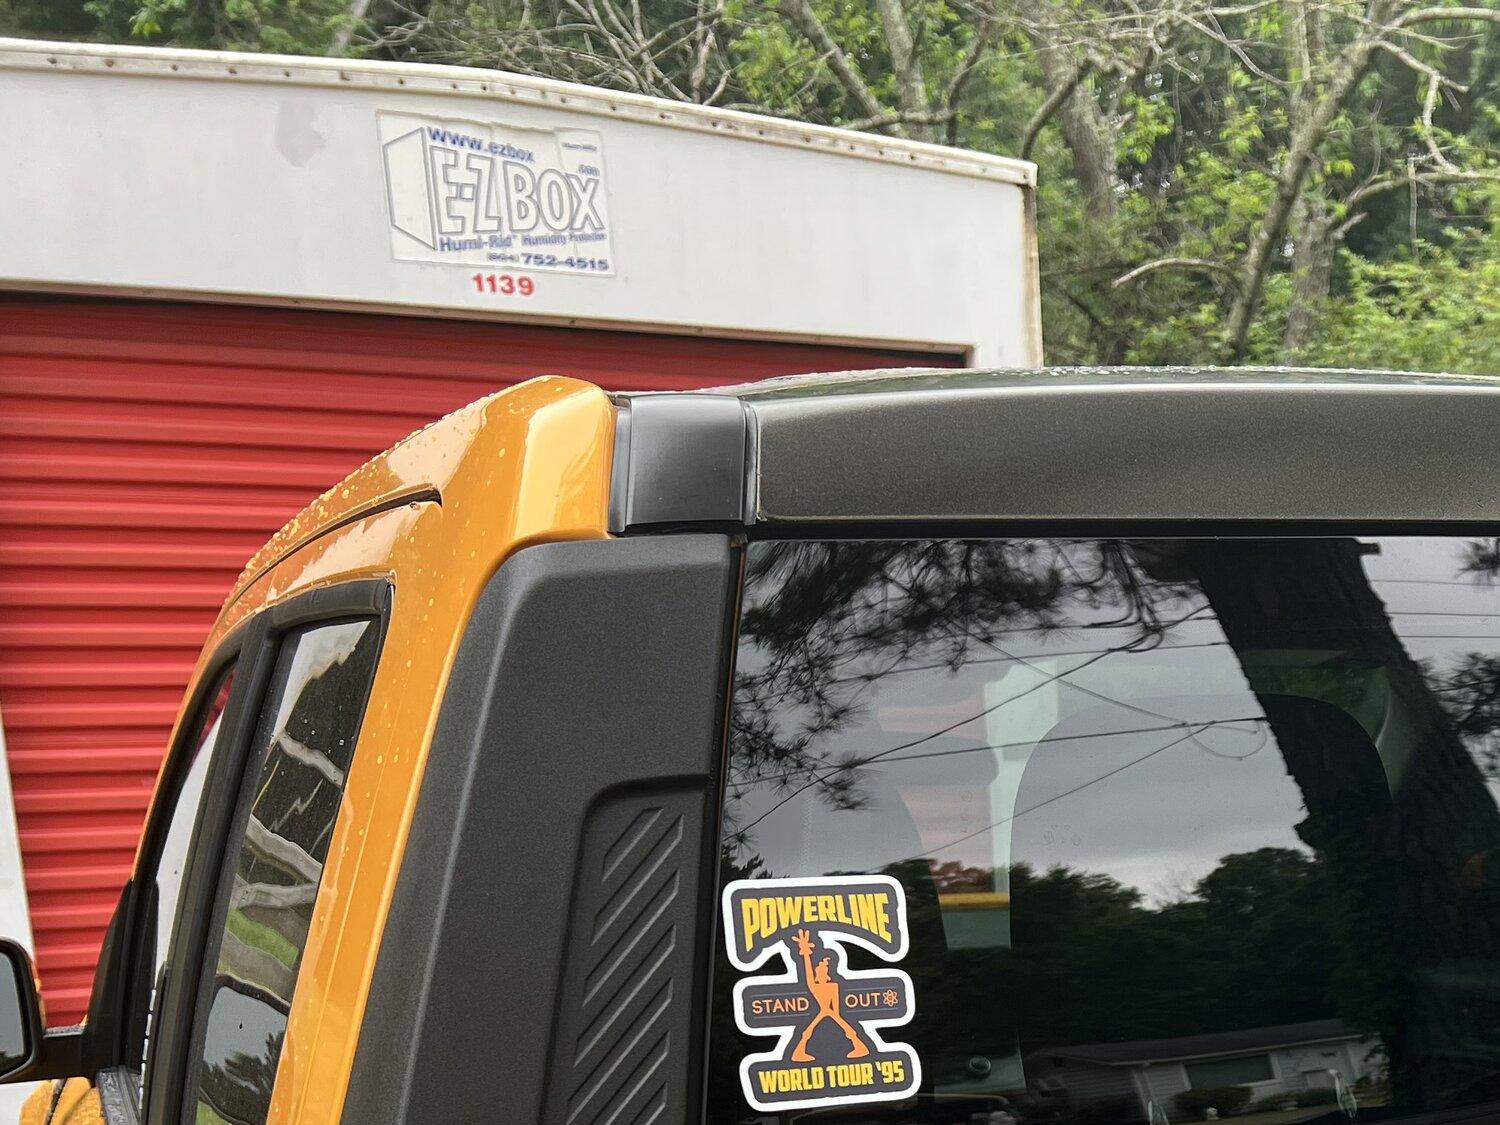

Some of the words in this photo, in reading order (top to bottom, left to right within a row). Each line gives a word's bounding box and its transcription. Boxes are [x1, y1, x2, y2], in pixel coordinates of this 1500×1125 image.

[521, 252, 609, 271] 752-4515
[472, 273, 535, 297] 1139
[741, 892, 892, 952] POWERLINE
[752, 997, 809, 1014] STAND
[845, 993, 880, 1008] OUT
[758, 1066, 825, 1094] WORLD
[827, 1062, 874, 1088] TOUR
[875, 1060, 905, 1083] '95
